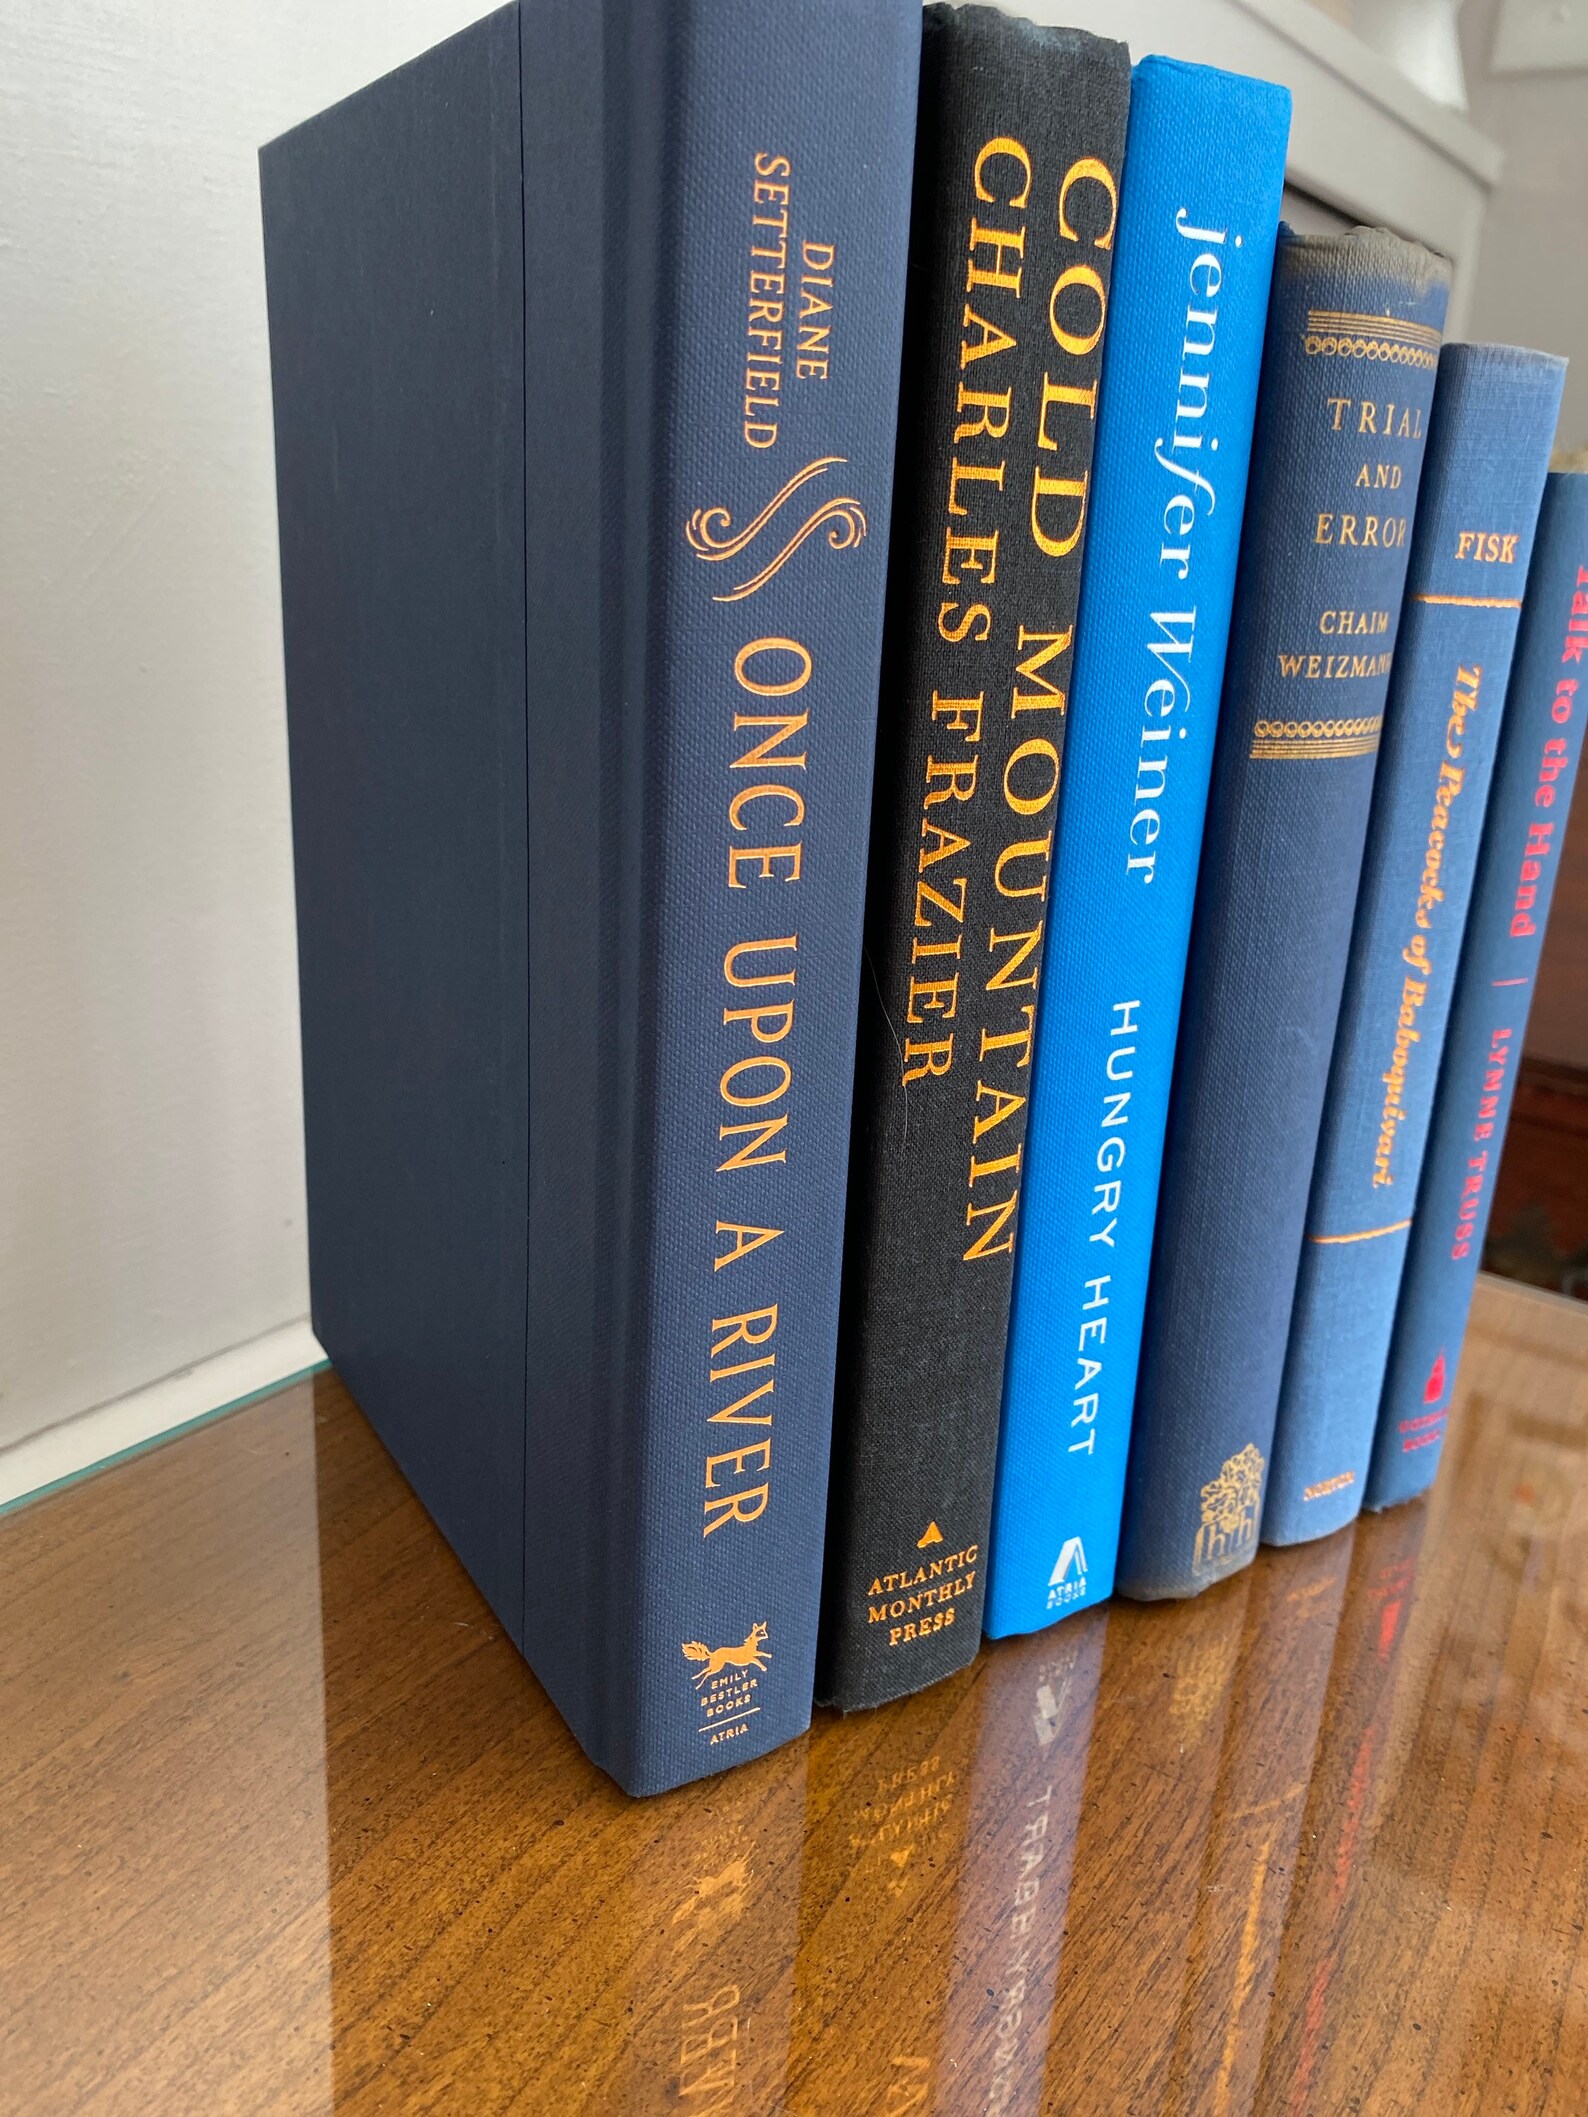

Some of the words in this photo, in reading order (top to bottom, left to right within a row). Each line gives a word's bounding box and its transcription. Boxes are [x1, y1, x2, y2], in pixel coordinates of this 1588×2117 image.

[744, 152, 791, 449] SETTERFIELD
[796, 240, 836, 380] DIANE
[936, 135, 1033, 644] CHARLES
[1030, 156, 1118, 559] COLD
[1155, 208, 1243, 579] jennifer
[1327, 397, 1422, 438] TRIAL
[1355, 464, 1402, 490] AND
[1313, 513, 1407, 549] ERROR
[1455, 531, 1519, 563] FISK
[1319, 609, 1389, 635] CHAIM
[1128, 608, 1197, 883] Weiner
[1446, 664, 1482, 758] The
[1551, 678, 1579, 724] to
[728, 636, 813, 889] ONCE
[1535, 737, 1568, 808] the
[901, 688, 985, 1087] FRAZIER
[1415, 760, 1465, 930] Peacocks
[1510, 821, 1555, 938] Hand
[962, 624, 1074, 1262] MOUNTAIN
[1402, 934, 1432, 975] of
[718, 934, 799, 1172] UPON
[1474, 1027, 1513, 1142] LYNNE
[1090, 1000, 1141, 1247] HUNGRY
[714, 1220, 784, 1272] A
[1451, 1149, 1489, 1260] TRUSS
[1069, 1275, 1111, 1455] HEART
[703, 1303, 779, 1538] RIVER
[867, 1544, 979, 1597] ATLANTIC
[867, 1571, 977, 1625] MONTHLY
[1048, 1576, 1087, 1600] ATRIA
[888, 1607, 956, 1647] PRESS
[700, 1678, 758, 1707] BESTLER
[706, 1694, 751, 1718] BOOKS
[710, 1669, 748, 1690] EMILY
[710, 1723, 749, 1746] ATRIA
